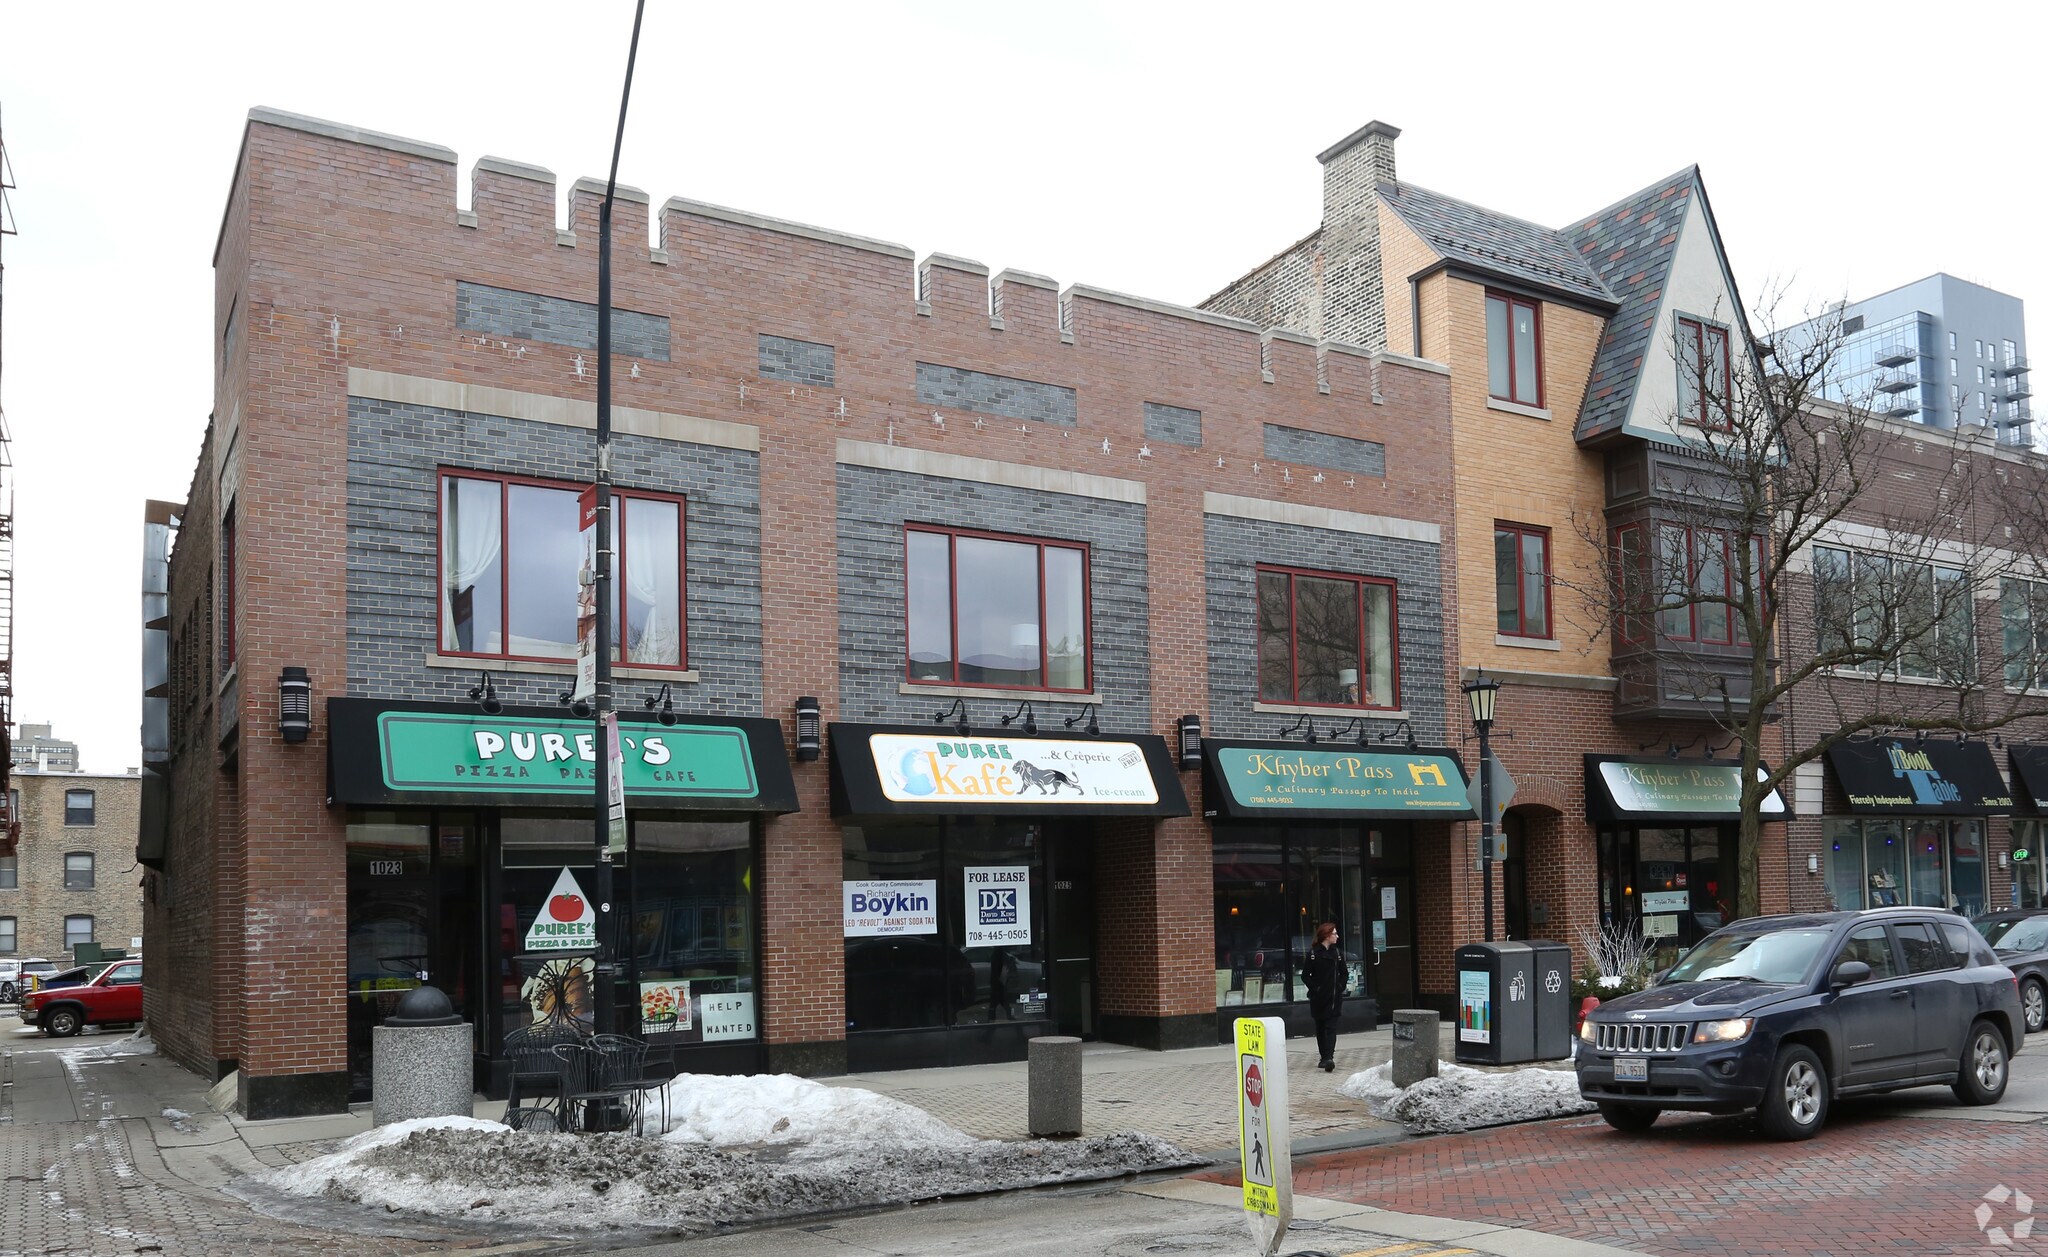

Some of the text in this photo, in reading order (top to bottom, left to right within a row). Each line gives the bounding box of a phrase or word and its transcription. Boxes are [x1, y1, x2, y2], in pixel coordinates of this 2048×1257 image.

[472, 730, 673, 766] PURE'S
[936, 742, 1013, 760] PUREE
[1064, 749, 1111, 764] Crêperie
[1899, 749, 1934, 771] Book
[454, 764, 698, 783] PIZZA PAS CAFE
[924, 751, 1017, 797] Kafé
[1247, 754, 1394, 783] Khyber Pass
[1620, 767, 1725, 791] Khyber Pass
[1093, 786, 1146, 797] Ice-cream
[1263, 784, 1420, 797] A Culinary Passage To India
[1893, 769, 1961, 804] Table
[1645, 792, 1680, 802] Culinary
[1681, 793, 1710, 802] Passage
[1712, 793, 1722, 801] To
[1725, 793, 1742, 801] Indi
[1848, 794, 1914, 807] Fiercely Independent
[372, 861, 402, 875] 1023
[968, 872, 1026, 882] FOR LEASE
[866, 890, 896, 898] Richard
[980, 890, 1015, 910] DK
[851, 892, 929, 916] Boykin
[884, 918, 907, 926] AGAINST
[908, 917, 924, 926] SODA
[925, 916, 936, 924] TAX
[968, 930, 1028, 941] 708-445-0505
[528, 940, 559, 948] PIZZA
[561, 939, 569, 947] &
[709, 1001, 742, 1012] HELP
[706, 1023, 752, 1034] WANTED
[1243, 1024, 1262, 1038] STATE
[1247, 1039, 1260, 1052] LAW
[1246, 1077, 1262, 1094] STOP
[1251, 1116, 1261, 1127] FOR
[1252, 1186, 1269, 1199] WITHIN
[1246, 1194, 1277, 1212] CROSSWALK
